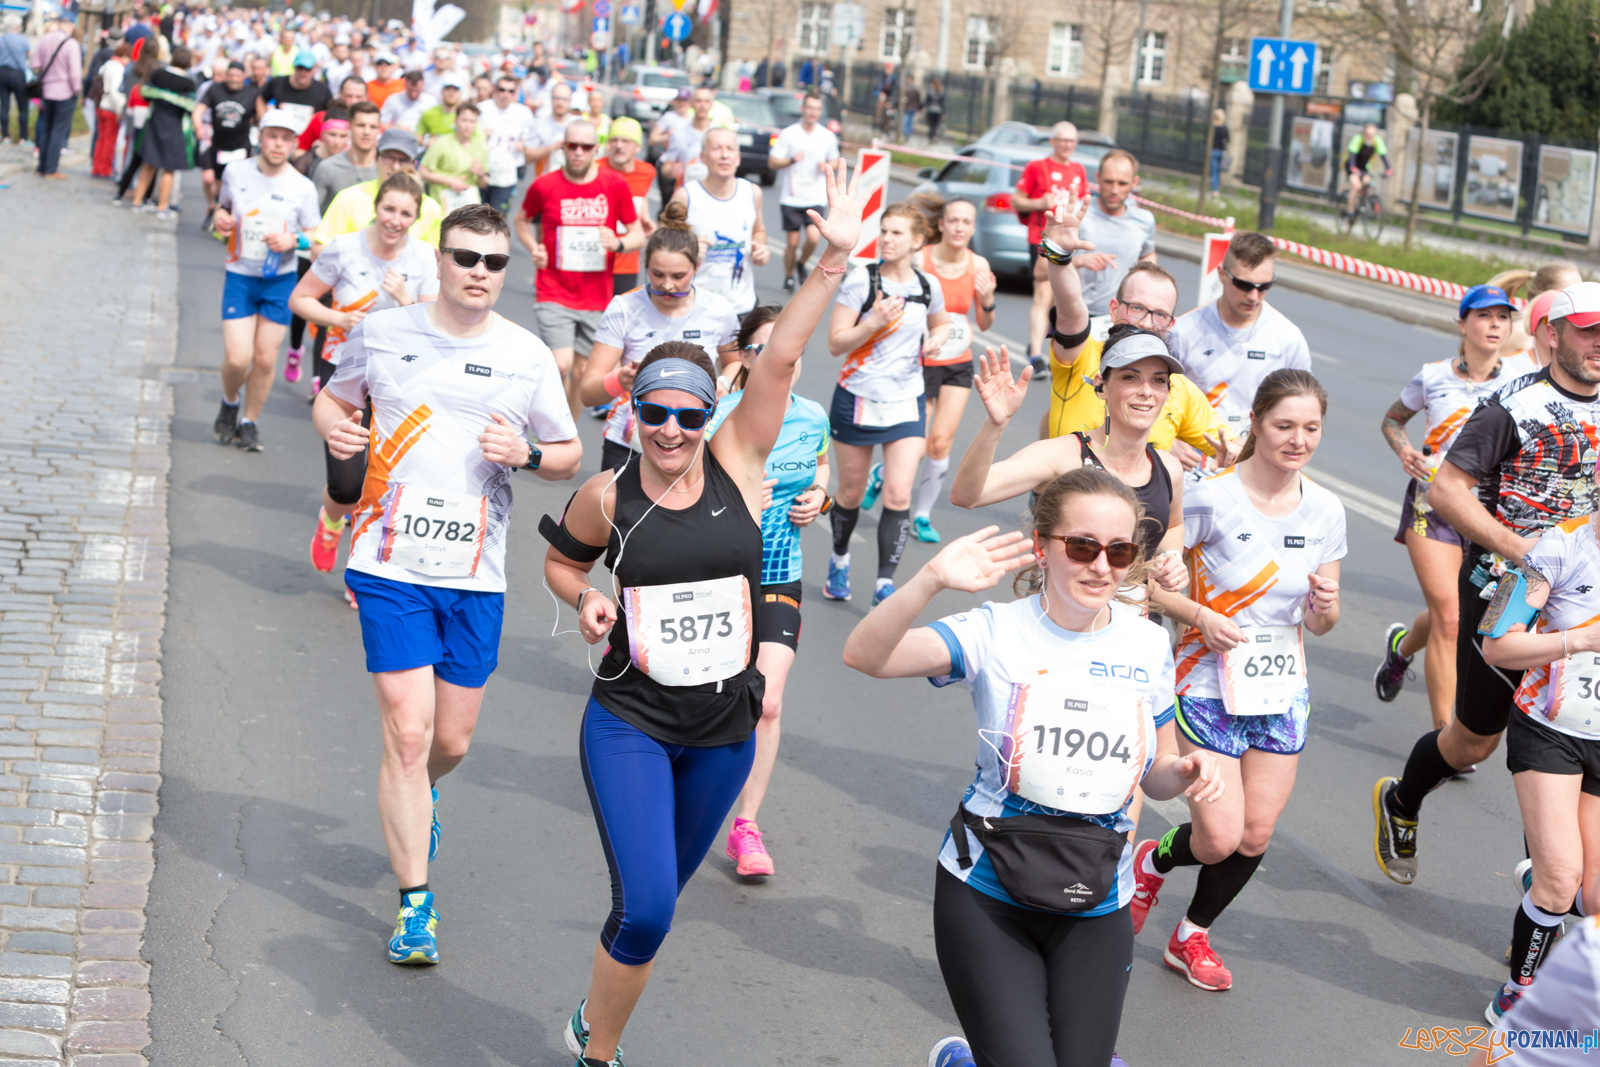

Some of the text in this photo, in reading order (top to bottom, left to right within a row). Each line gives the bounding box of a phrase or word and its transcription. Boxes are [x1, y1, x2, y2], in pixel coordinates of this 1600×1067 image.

[569, 241, 600, 253] 4555
[403, 514, 476, 543] 10782
[424, 543, 447, 552] Patryk
[660, 611, 733, 645] 5873
[687, 647, 711, 656] Anna
[1244, 654, 1297, 678] 6292
[1033, 724, 1132, 764] 11904
[1065, 765, 1093, 776] Kasia
